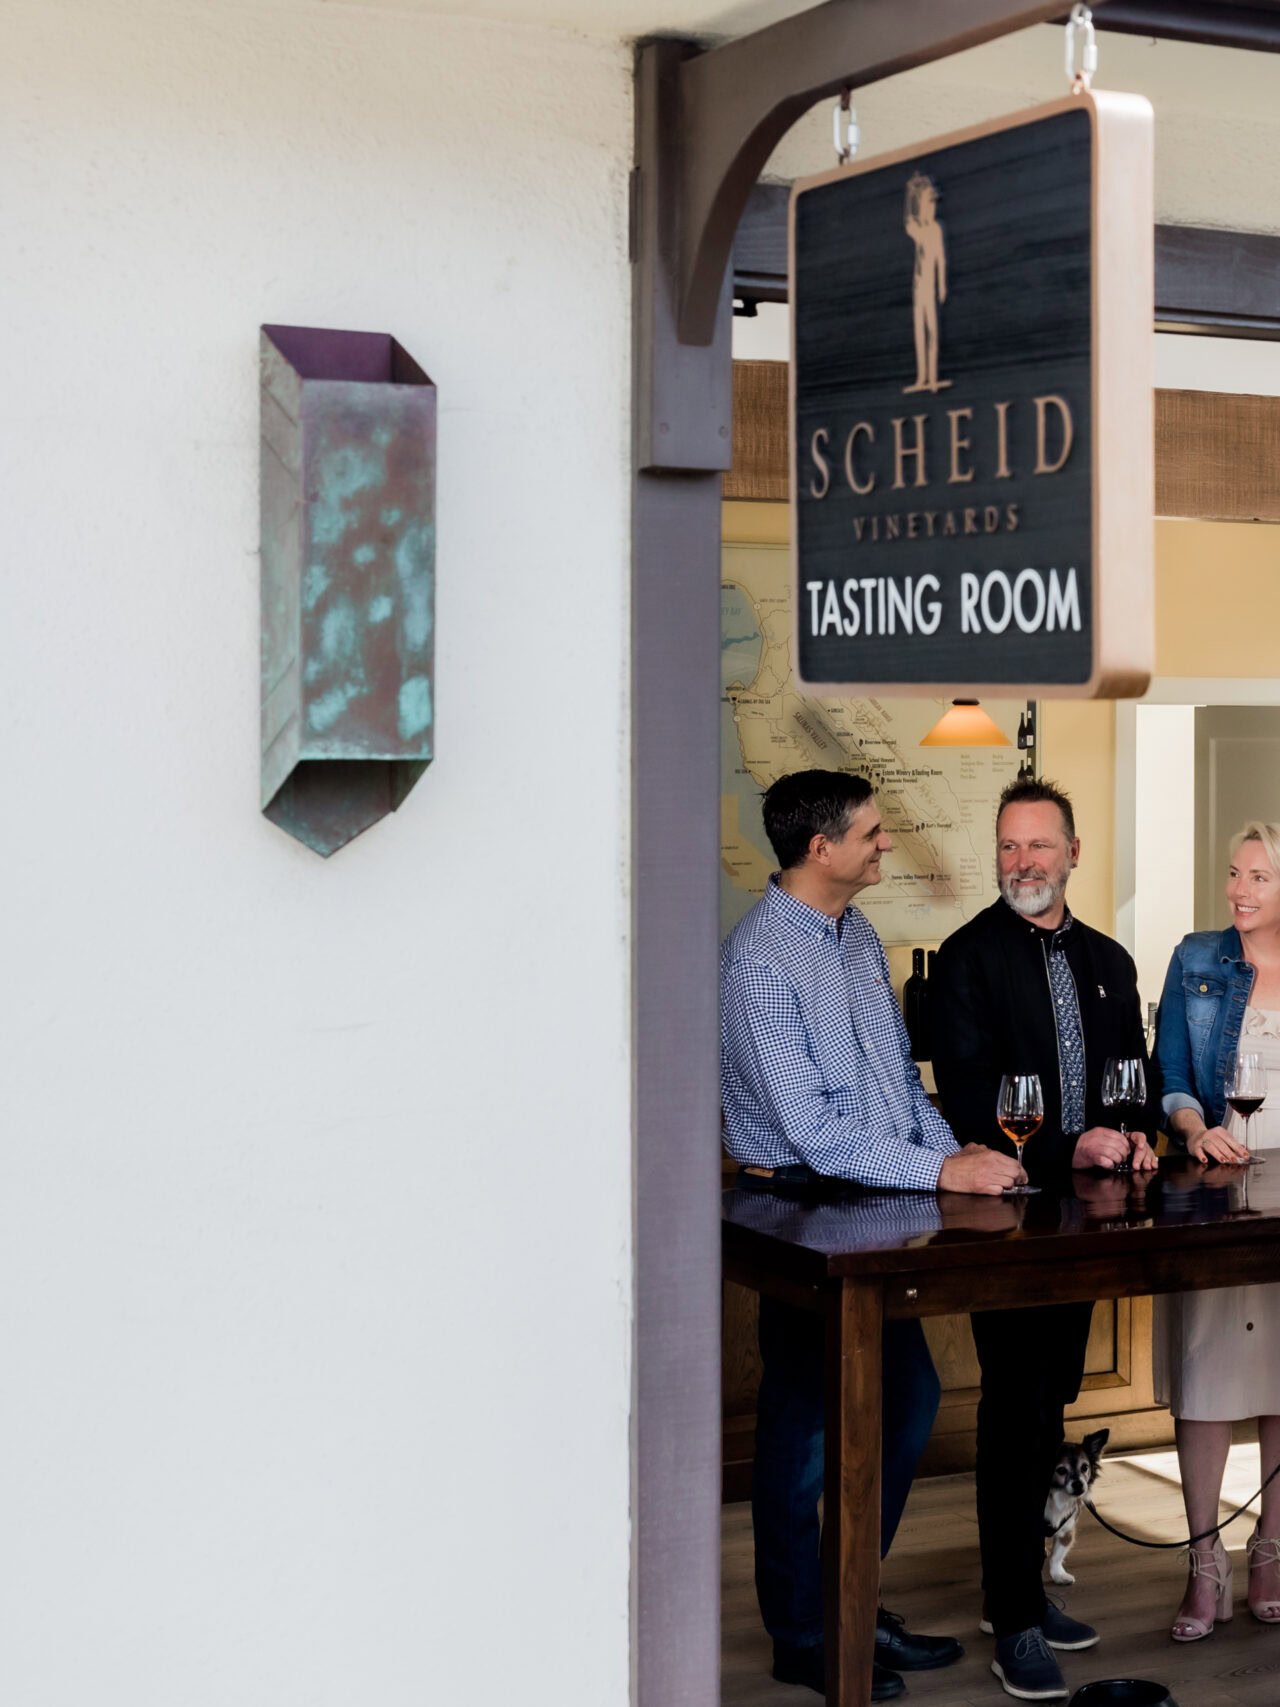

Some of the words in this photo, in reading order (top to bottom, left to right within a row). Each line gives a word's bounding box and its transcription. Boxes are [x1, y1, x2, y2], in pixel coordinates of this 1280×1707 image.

[808, 394, 1075, 500] SCHEID
[851, 502, 1022, 542] VINEYARDS
[806, 573, 943, 637] TASTING
[960, 567, 1083, 635] ROOM
